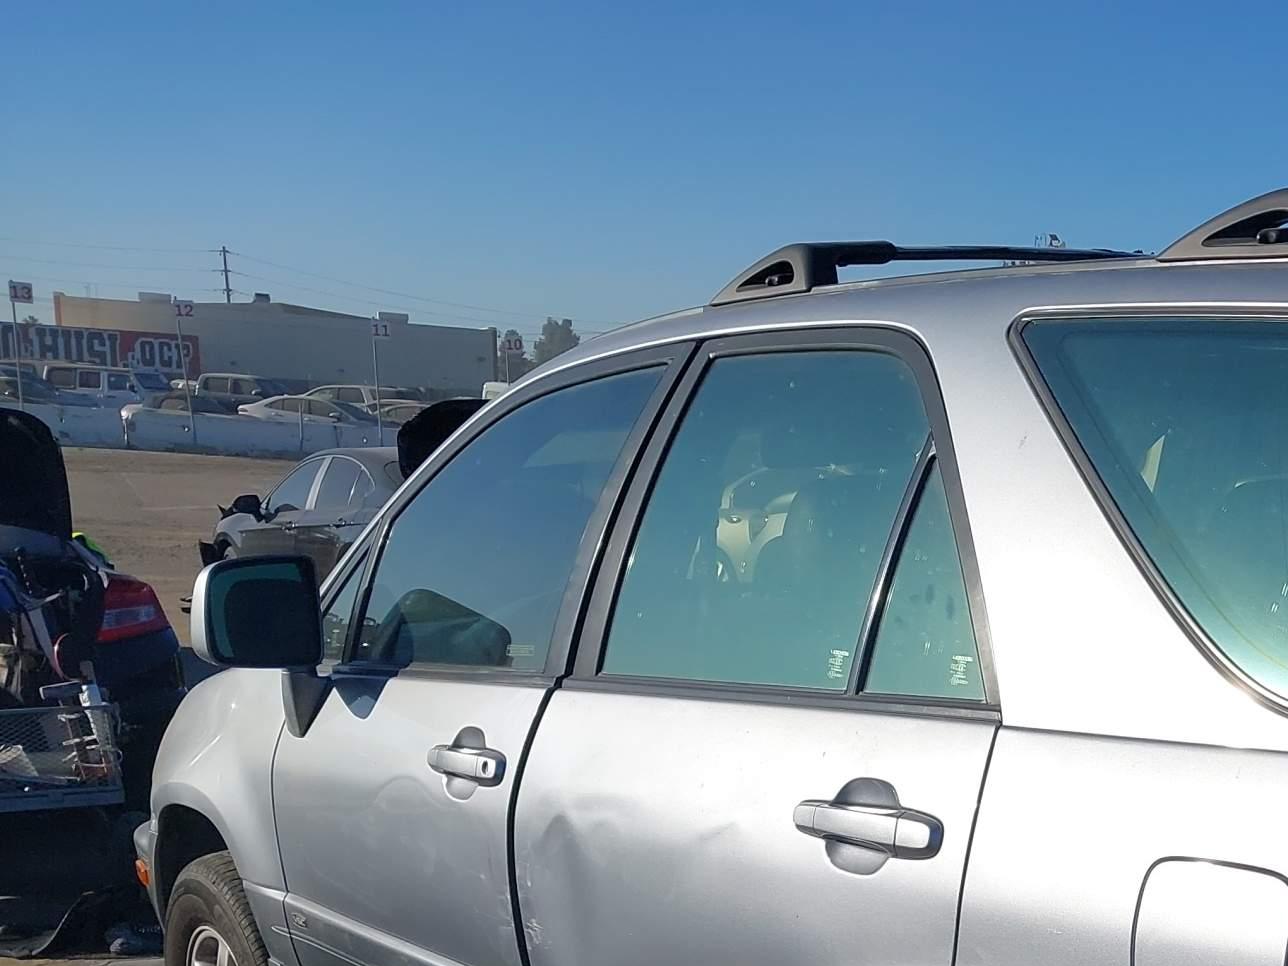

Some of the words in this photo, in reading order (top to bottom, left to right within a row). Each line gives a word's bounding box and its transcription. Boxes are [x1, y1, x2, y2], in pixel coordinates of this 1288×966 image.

[10, 284, 33, 299] 13
[174, 303, 194, 317] 12
[372, 323, 390, 337] 11
[506, 339, 523, 351] 10
